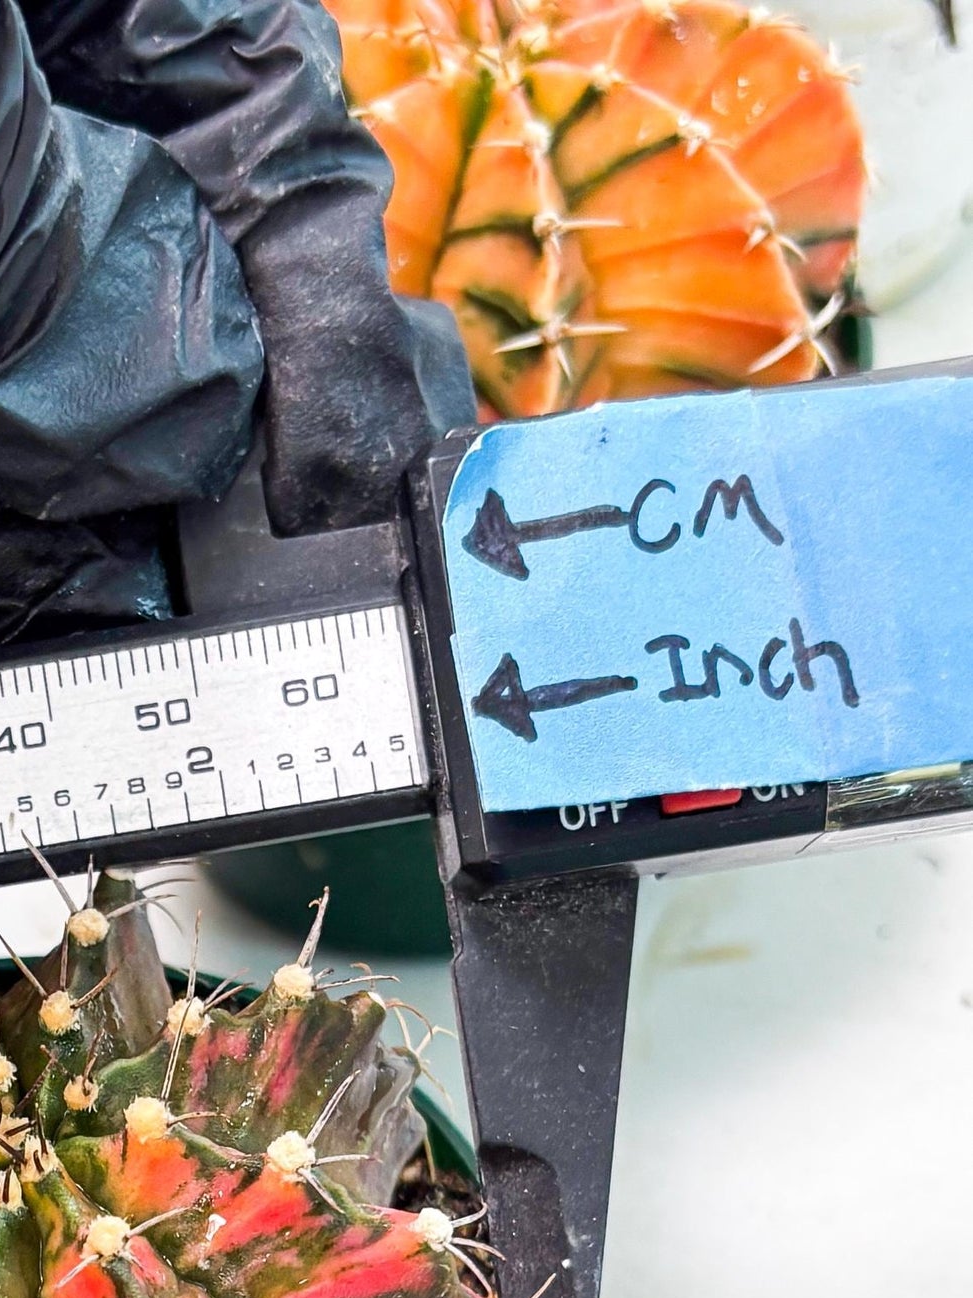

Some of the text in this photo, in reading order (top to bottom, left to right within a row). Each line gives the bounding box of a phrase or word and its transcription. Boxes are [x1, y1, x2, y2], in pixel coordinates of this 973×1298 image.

[645, 617, 860, 708] Inch
[134, 698, 191, 731] 50
[282, 674, 339, 706] 60
[17, 795, 34, 813] 5
[54, 789, 71, 807] 6
[93, 783, 108, 800] 7
[127, 777, 146, 795] 8
[165, 771, 183, 789] 9
[186, 746, 215, 775] 2
[247, 759, 257, 775] 1
[277, 753, 295, 771] 2
[314, 746, 331, 763] 3
[351, 740, 367, 757] 4
[389, 734, 406, 752] 5
[559, 801, 628, 831] OFF
